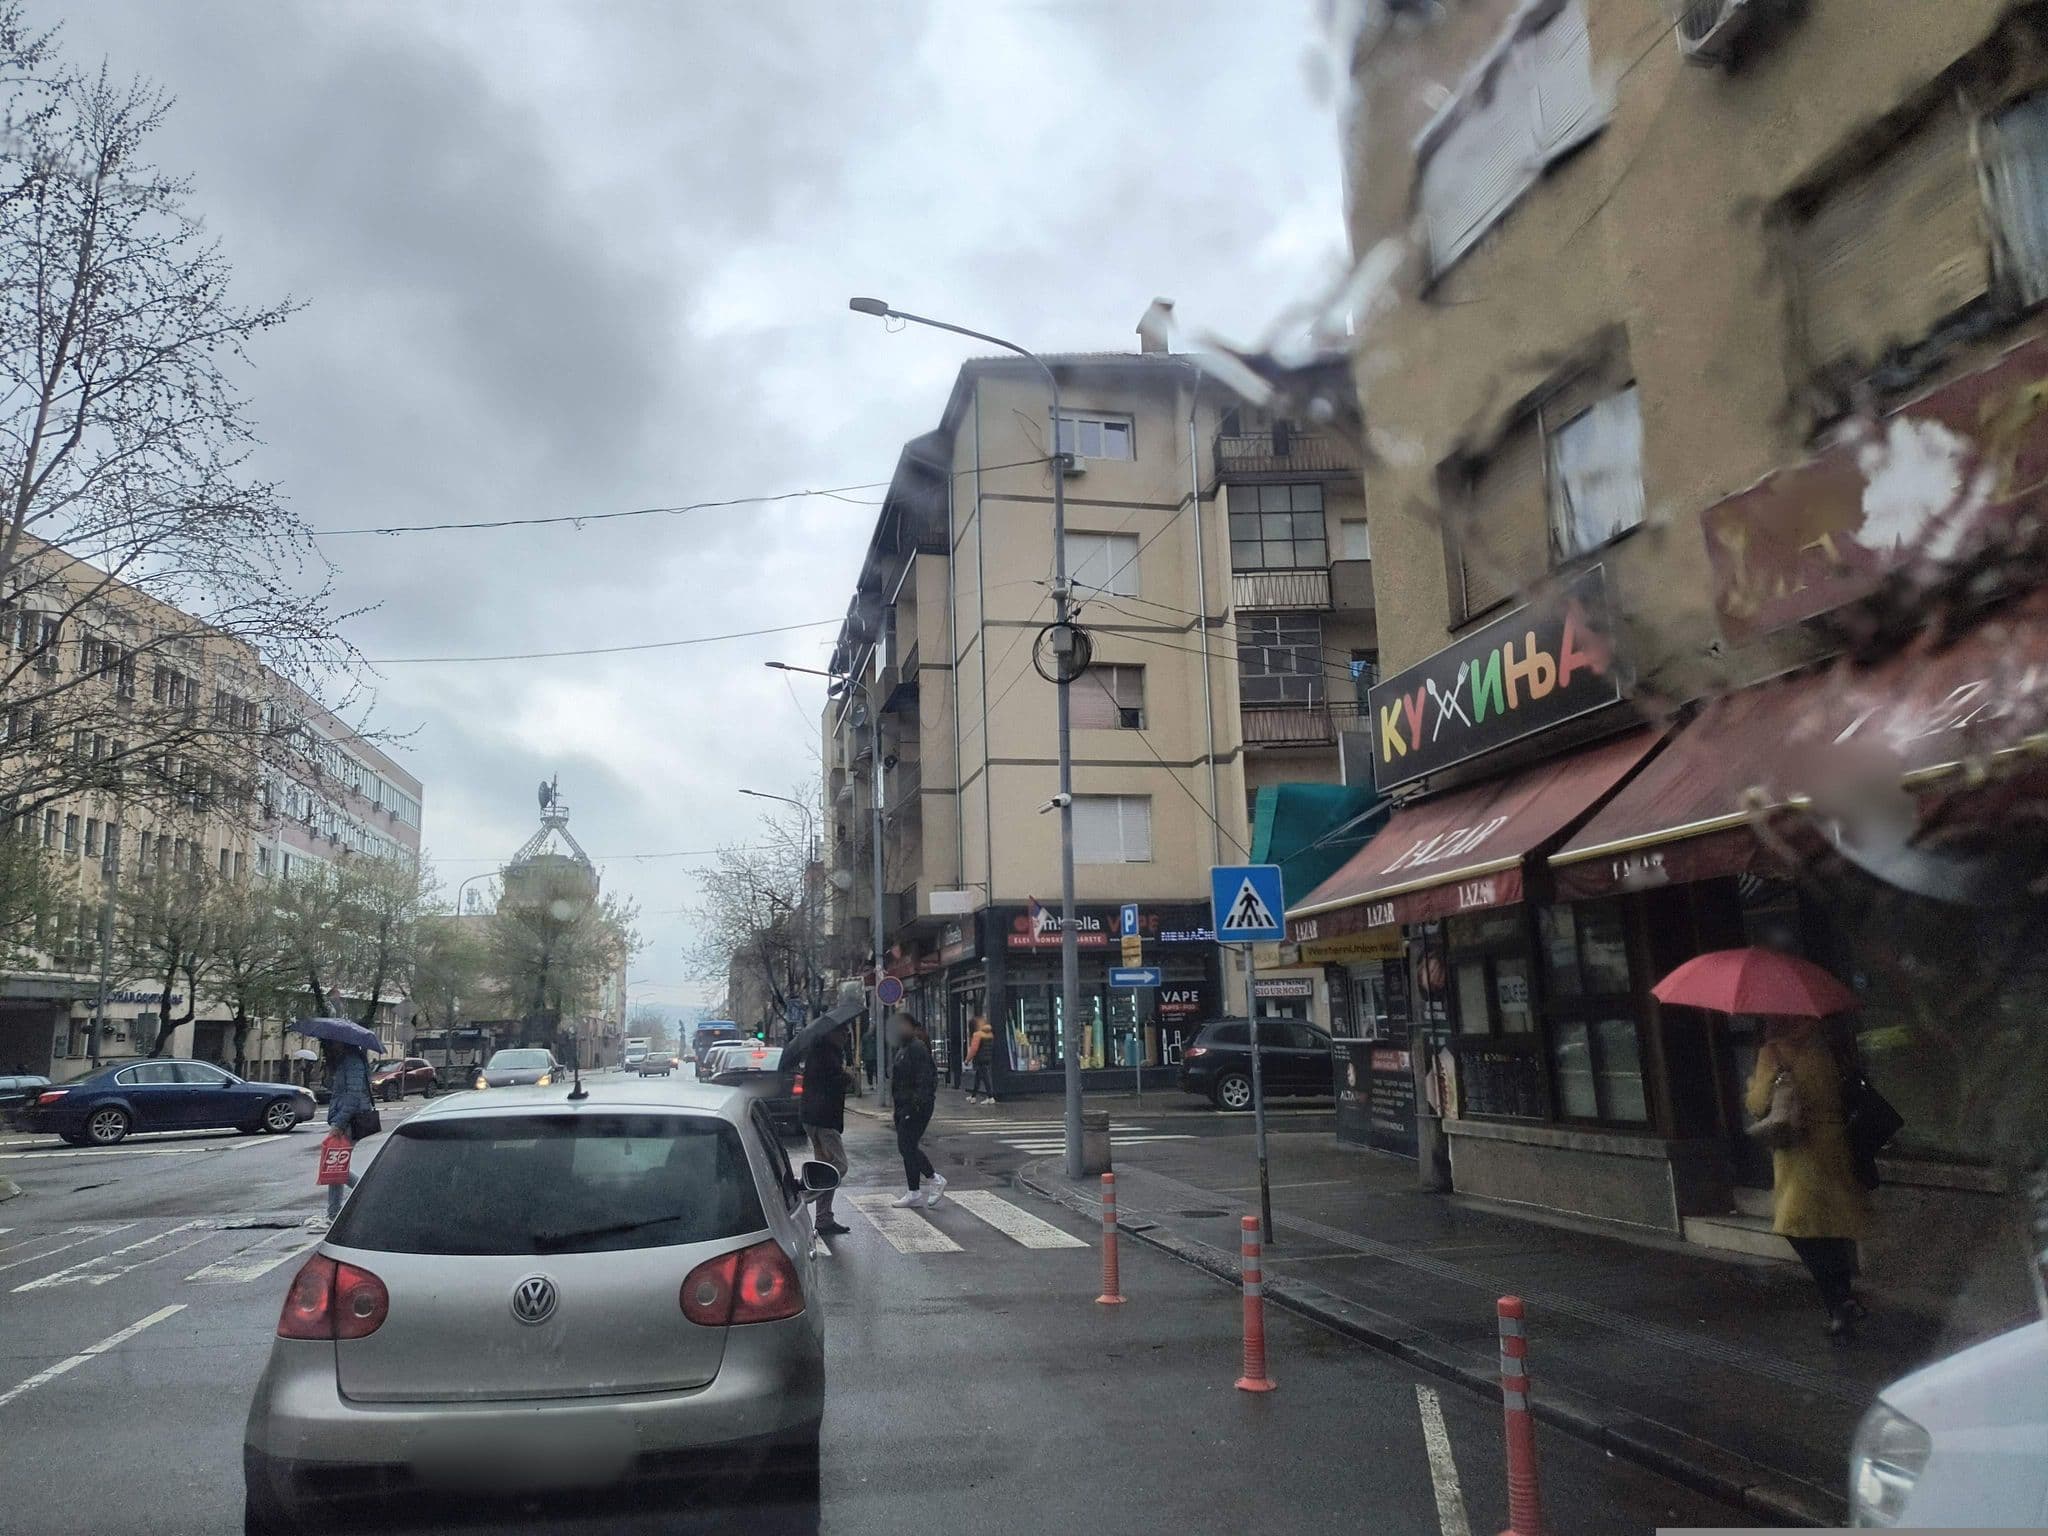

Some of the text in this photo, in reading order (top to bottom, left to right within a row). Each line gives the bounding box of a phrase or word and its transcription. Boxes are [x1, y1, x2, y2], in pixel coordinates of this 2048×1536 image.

[1380, 601, 1610, 763] КУХИЊА
[1379, 816, 1508, 876] LAZAR
[1124, 909, 1134, 932] P
[1367, 902, 1395, 928] LAZAR
[1161, 990, 1199, 1002] VAPE
